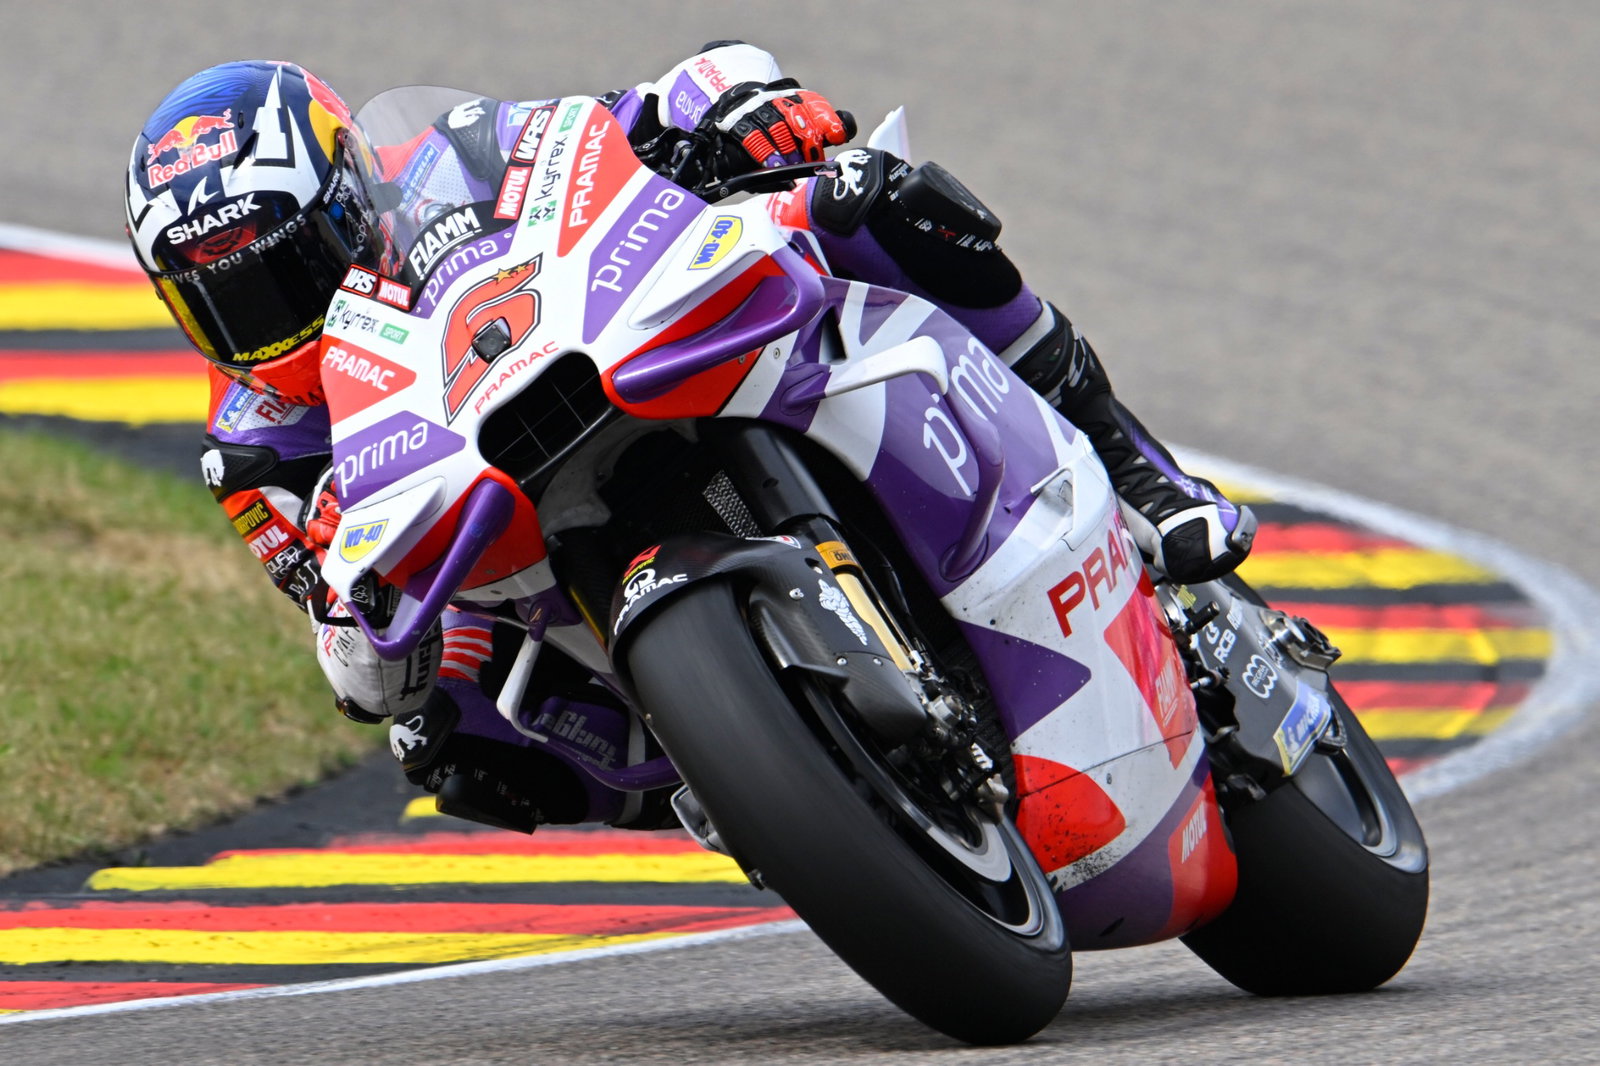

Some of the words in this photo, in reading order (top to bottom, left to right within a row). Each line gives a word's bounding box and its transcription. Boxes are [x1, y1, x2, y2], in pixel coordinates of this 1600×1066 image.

[148, 153, 192, 188] Red
[192, 130, 238, 169] Bull
[535, 136, 568, 202] kyrrex
[568, 121, 611, 228] PRAMAC
[167, 193, 262, 245] SHARK
[499, 169, 528, 217] MOTUL
[162, 270, 201, 285] GIVES
[207, 253, 242, 275] YOU
[249, 214, 307, 255] WINGS
[408, 207, 481, 277] FIAMM
[591, 188, 686, 293] prima
[695, 219, 734, 265] WD-40
[379, 282, 409, 307] MOTUL
[424, 239, 499, 306] prima
[321, 346, 396, 392] PRAMAC
[474, 340, 559, 415] PRAMAC
[335, 421, 428, 498] prima
[248, 525, 289, 559] OTUL
[345, 523, 383, 549] WD-40
[1213, 629, 1237, 664] RCB
